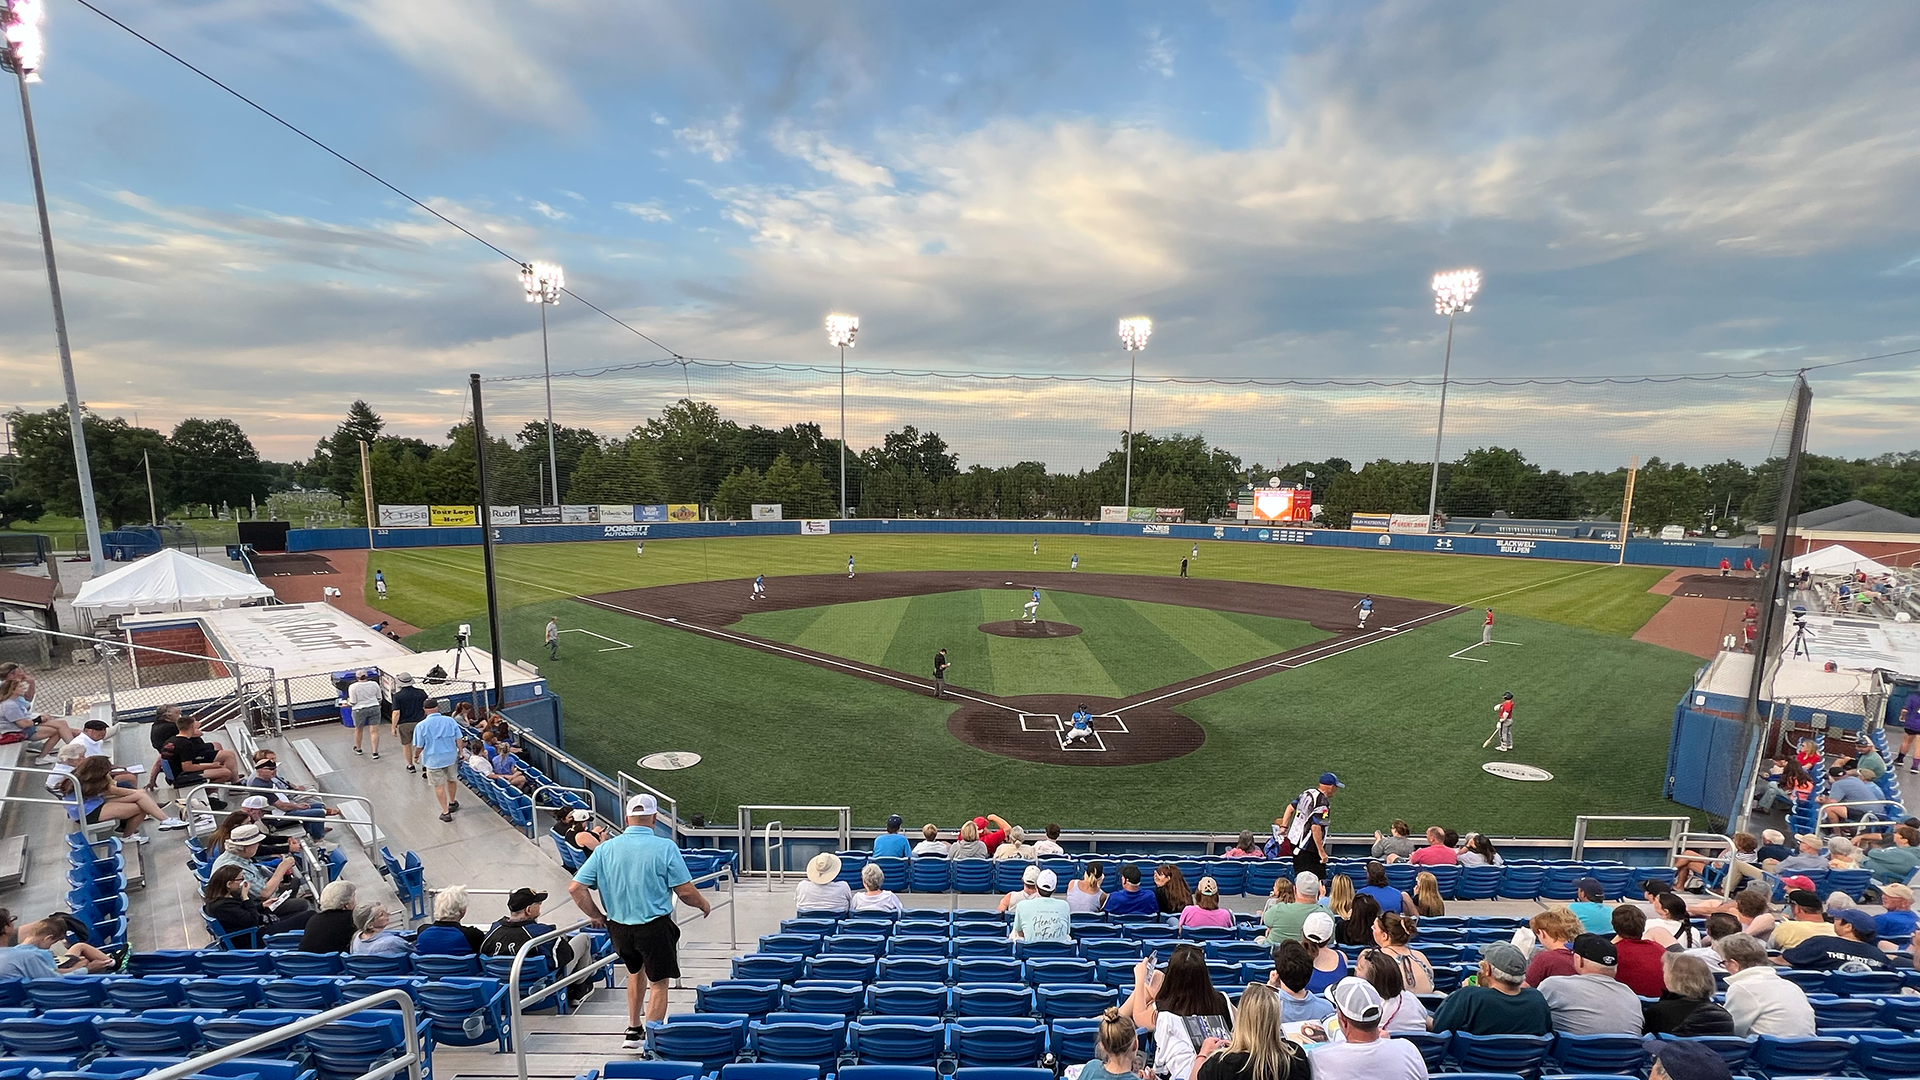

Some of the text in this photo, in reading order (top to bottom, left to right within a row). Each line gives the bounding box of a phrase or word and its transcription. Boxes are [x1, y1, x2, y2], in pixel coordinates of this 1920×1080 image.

[492, 509, 517, 517] Ruoff
[1496, 540, 1537, 548] BLACKWELL
[1500, 546, 1530, 554] BULLPEN
[275, 622, 372, 652] Ruoff
[1826, 951, 1845, 960] THE
